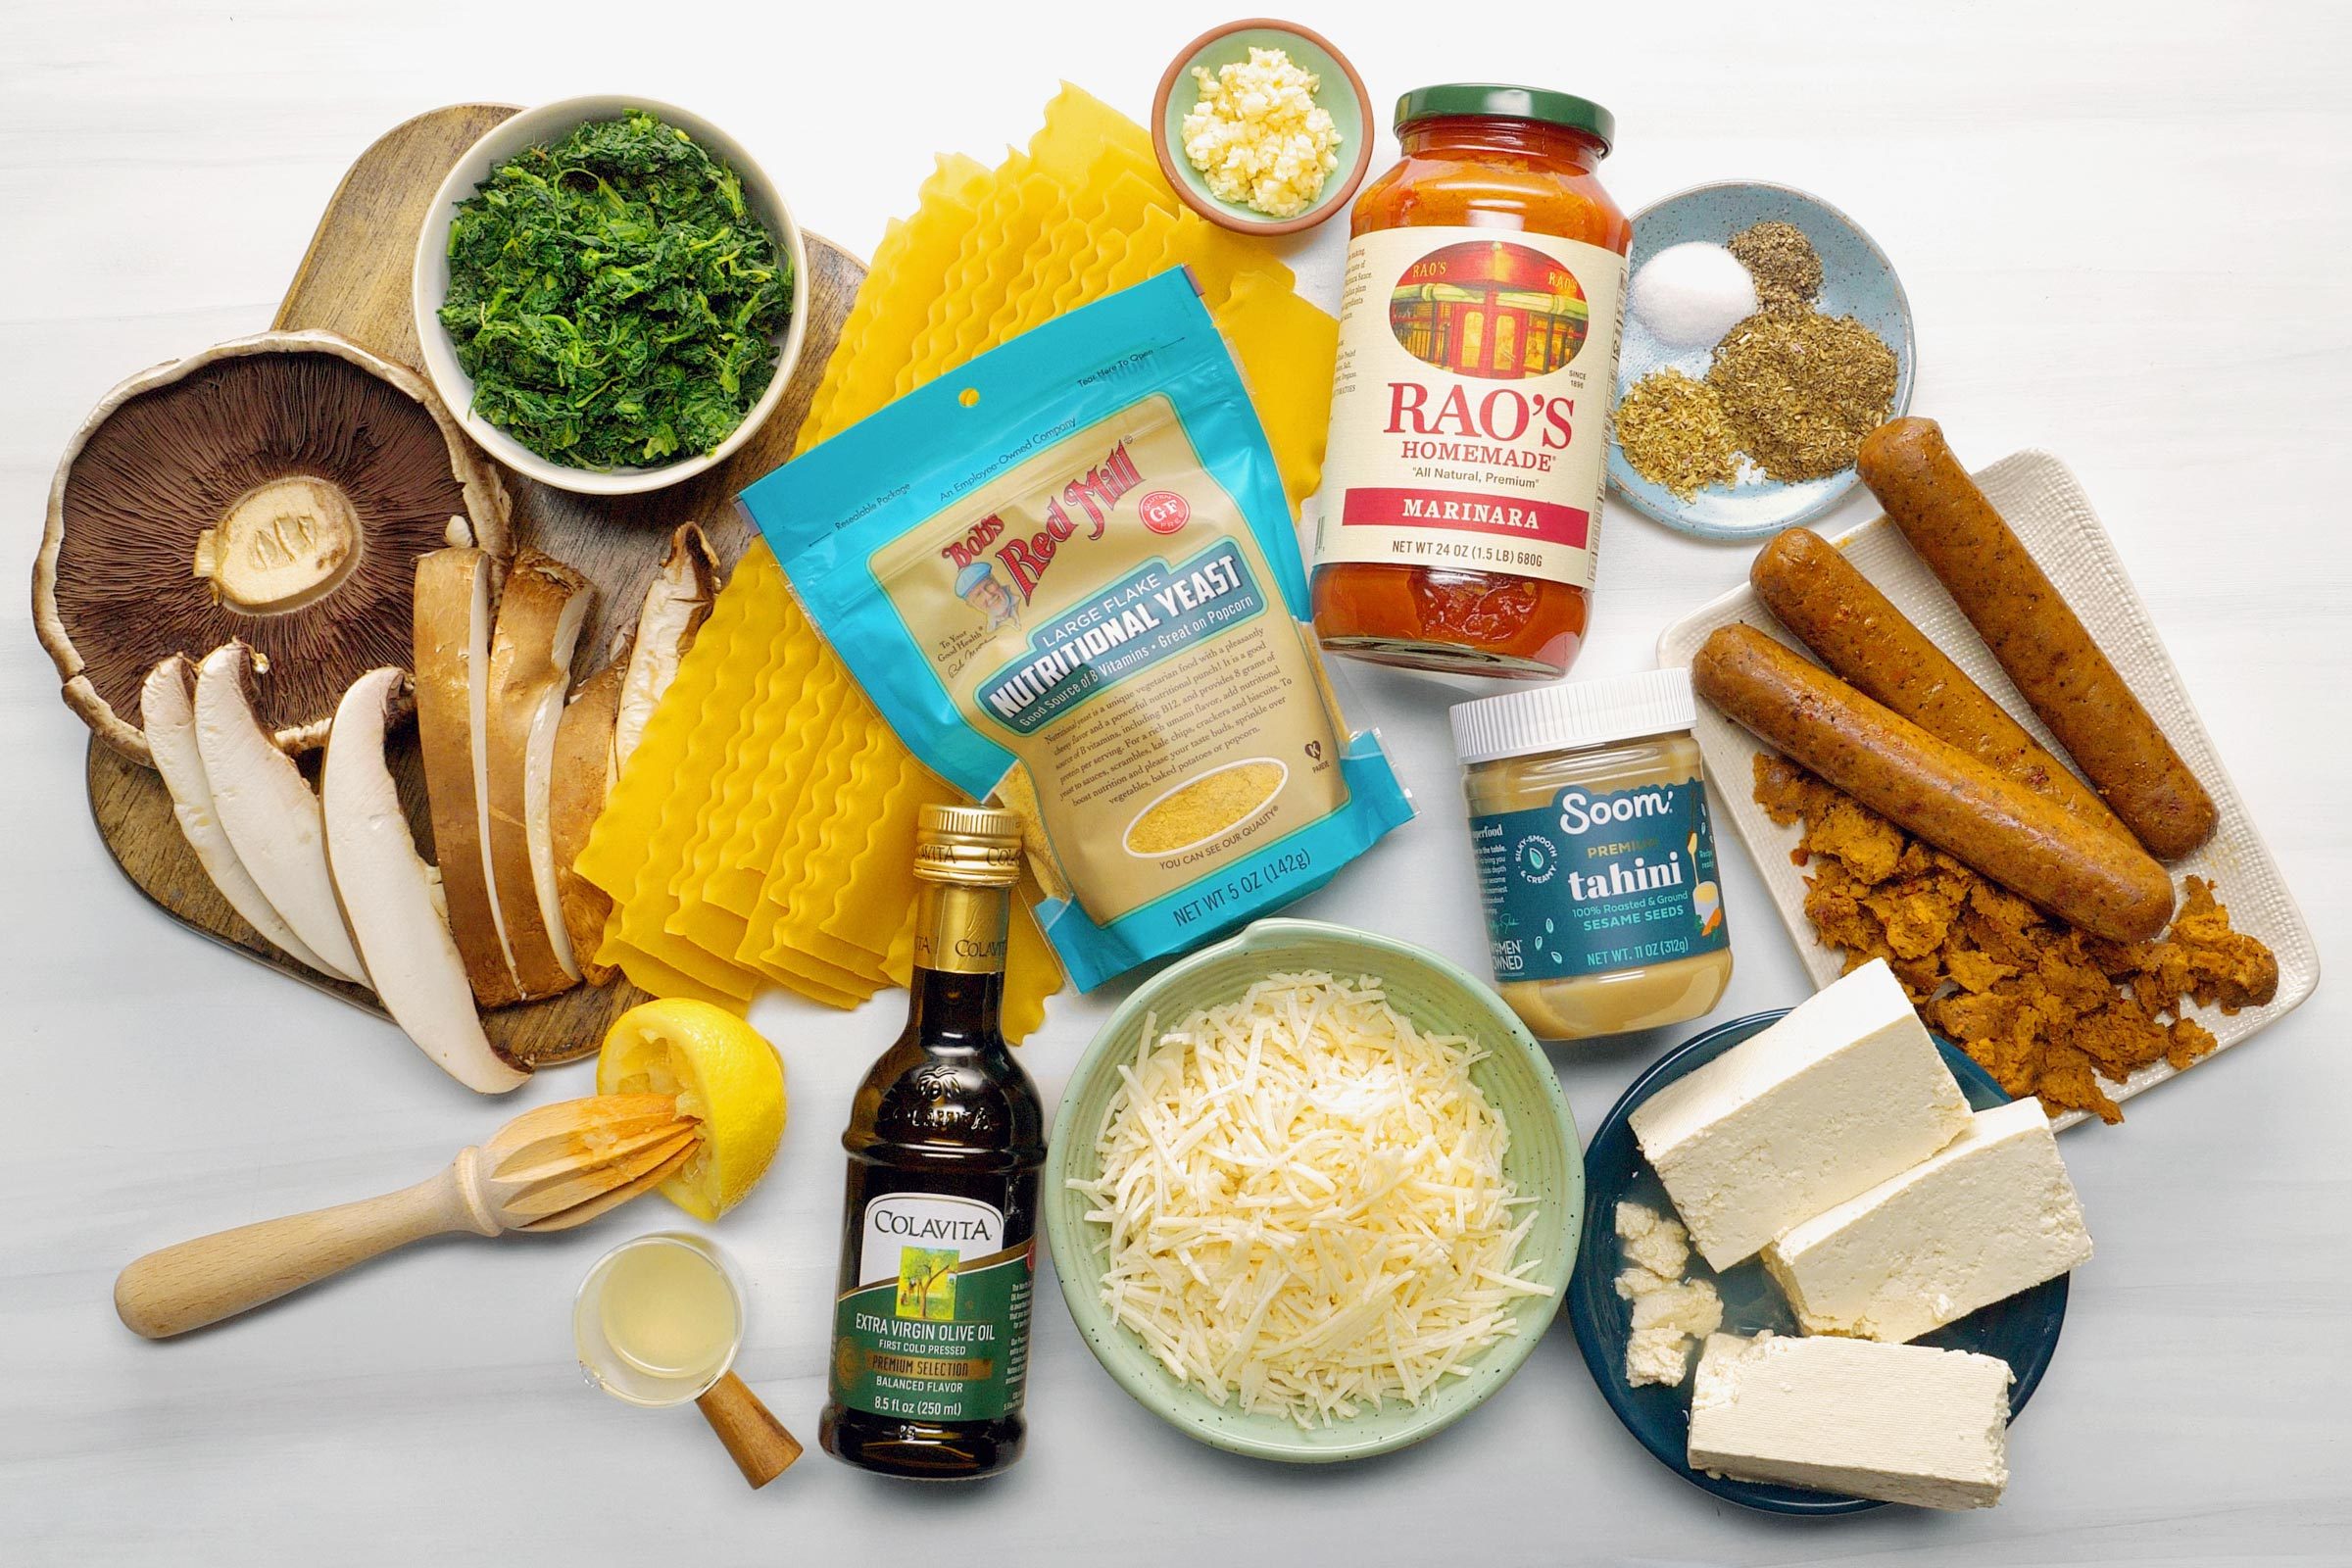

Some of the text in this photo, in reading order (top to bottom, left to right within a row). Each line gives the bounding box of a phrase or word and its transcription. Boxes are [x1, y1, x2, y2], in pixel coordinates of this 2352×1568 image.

[1412, 261, 1447, 278] RAO'S
[1547, 270, 1578, 293] RAO'S
[1077, 349, 1153, 388] Tear Here To Open
[1568, 369, 1587, 381] SINCE
[1383, 382, 1575, 450] RAO'S
[939, 416, 1078, 503] An Employee-Owned Company
[1435, 467, 1482, 484] Natural,
[1485, 472, 1540, 489] Premium"
[835, 481, 911, 531] Resealable Package
[1150, 499, 1178, 522] GF
[1402, 499, 1540, 530] MARINARA
[941, 513, 1005, 570] Bob's
[995, 495, 1079, 608] Red
[1393, 540, 1543, 567] NET WT 24 OZ (1.5 LB) 680G
[1042, 572, 1162, 648] LARGE FLAKE
[939, 630, 967, 649] To Your
[989, 603, 1161, 718] NUTRITIONAL
[1153, 555, 1243, 617] YEAST
[937, 645, 957, 662] Good
[1019, 594, 1254, 727] Good Source of B Vitamins Great on Popcorn
[1105, 691, 1135, 709] unique
[1136, 669, 1179, 694] vegetarian
[1178, 656, 1199, 673] food
[1199, 648, 1218, 664] with
[1225, 626, 1264, 654] pleasantly
[1079, 746, 1087, 756] B
[1086, 732, 1121, 752] vitamins,
[1122, 710, 1161, 734] including
[1182, 689, 1199, 704] and
[1199, 674, 1235, 697] provides
[1242, 659, 1267, 677] grams
[1266, 651, 1276, 662] of
[1090, 721, 1104, 735] and
[1111, 698, 1149, 726] powerful
[1149, 676, 1193, 705] nutritional
[1193, 662, 1223, 685] punch!
[1247, 640, 1267, 659] good
[1080, 760, 1093, 774] per
[1093, 746, 1125, 764] serving.
[1124, 736, 1141, 748] For
[1148, 721, 1166, 738] rich
[1166, 708, 1195, 728] umami
[1194, 696, 1223, 714] flavor,
[1223, 685, 1239, 702] add
[1239, 664, 1282, 693] nutritional
[1082, 677, 1293, 786] sauces, scrambles, kale chips, crackers and biscuits. To
[1071, 696, 1287, 807] boost nutrition and please your taste buds, sprinkle over
[1108, 728, 1260, 805] vegetables, baked potatoes popcorn.
[1159, 857, 1184, 870] YOU
[1183, 851, 1205, 864] CAN
[1205, 843, 1222, 858] SEE
[1222, 832, 1243, 849] OUR
[1514, 834, 1558, 862] SILKY-SMOOTH
[1172, 848, 1311, 927] NET WT 5 OZ (142g)
[1526, 864, 1557, 884] CREAMY
[1568, 851, 1684, 902] tahini
[1572, 891, 1689, 918] 100% Roasted & Ground
[1584, 905, 1685, 931] SESAME SEEDS
[1587, 937, 1689, 966] NET WT. 11 OZ (312g)
[874, 1209, 991, 1242] COLAVITA
[856, 1312, 996, 1342] EXTRA VIRGIN OLIVE OIL
[879, 1339, 966, 1355] FIRST COLD PRESSED
[872, 1355, 969, 1377] PREMIUM SELECTION
[876, 1375, 963, 1393] BALANCED FLAVOR
[874, 1396, 961, 1416] 8.5 fl oz (250 ml)
